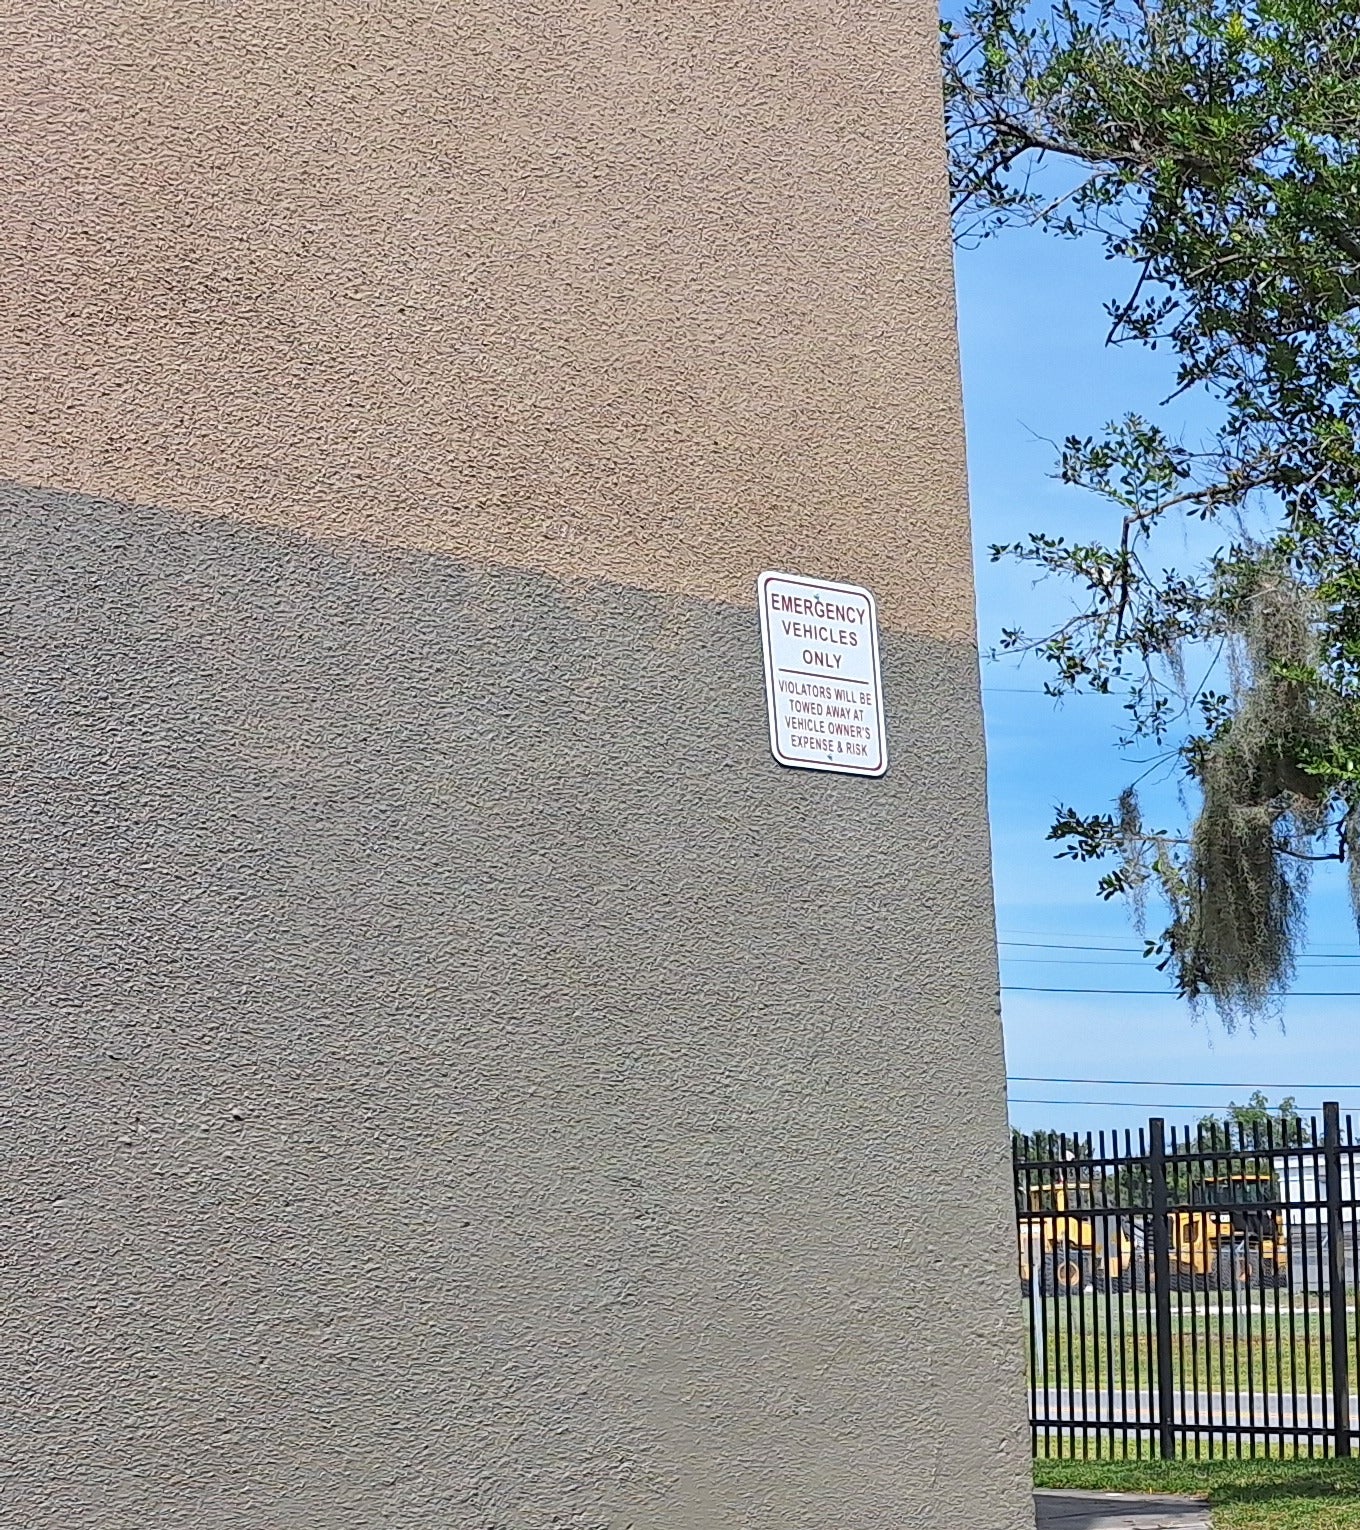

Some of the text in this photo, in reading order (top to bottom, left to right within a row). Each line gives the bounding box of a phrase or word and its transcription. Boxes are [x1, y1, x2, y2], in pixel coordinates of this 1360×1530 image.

[771, 593, 865, 625] EMERGENCY
[782, 620, 858, 646] VEHICLES
[802, 649, 842, 669] ONLY
[779, 680, 872, 706] VIOLATORS WILL BE
[789, 699, 864, 721] TOWED AWAY AT
[785, 716, 871, 740] VEHICLE OWNER'S
[791, 734, 868, 757] EXPENSE & RISK
